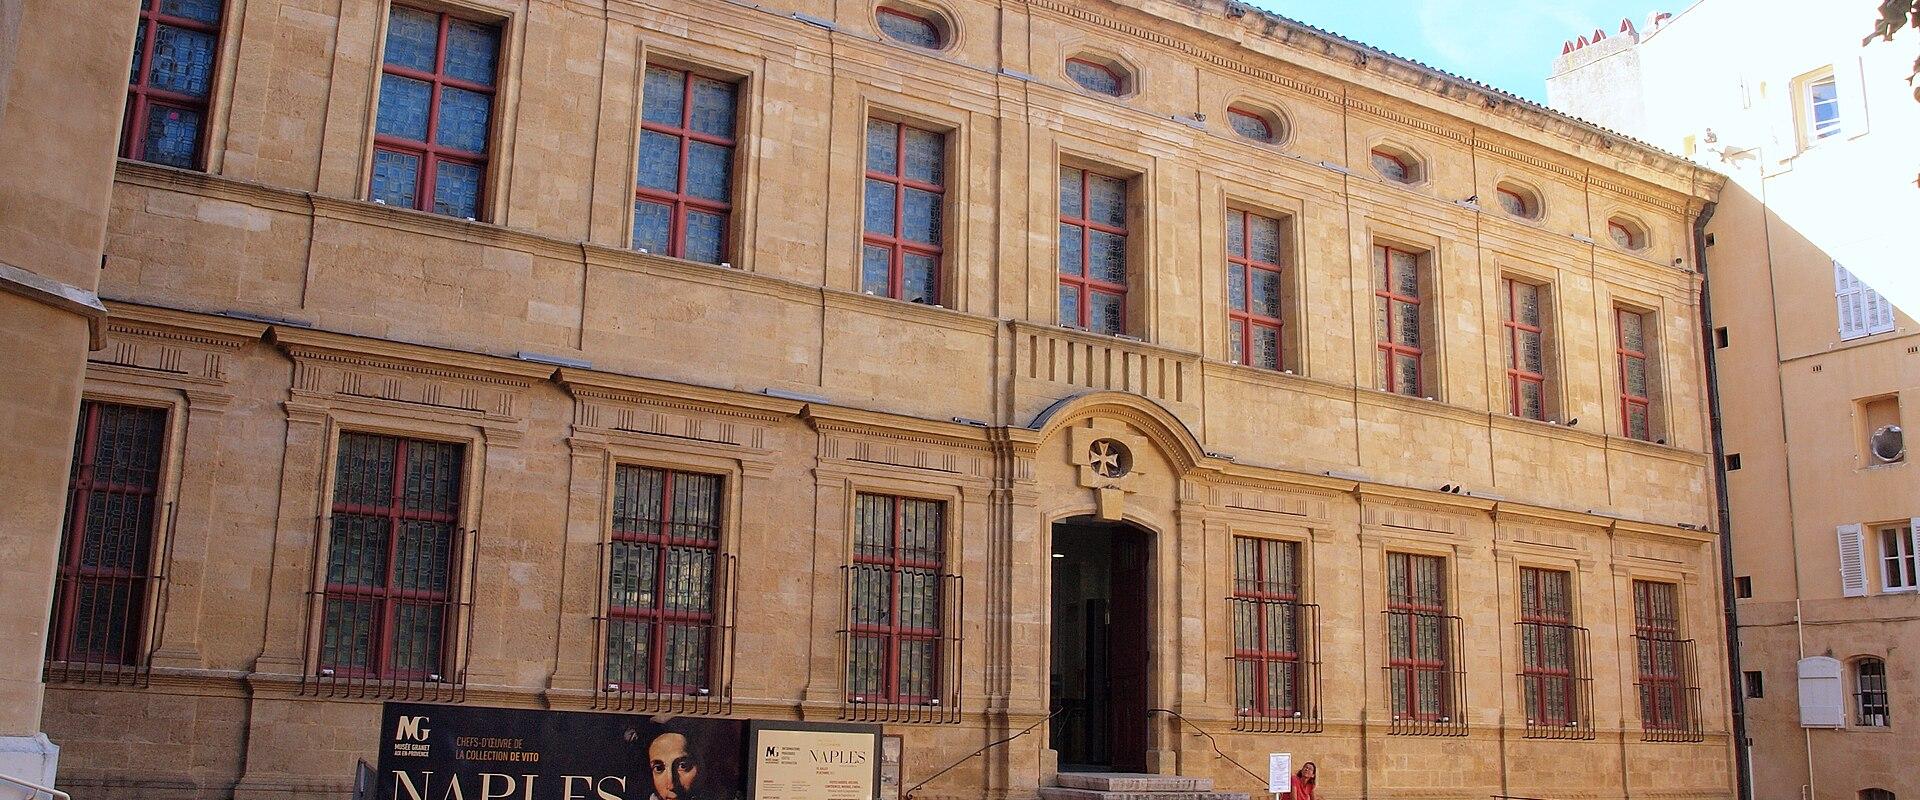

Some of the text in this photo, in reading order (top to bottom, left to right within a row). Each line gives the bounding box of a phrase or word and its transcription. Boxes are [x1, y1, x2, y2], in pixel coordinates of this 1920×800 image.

[396, 716, 431, 741] MG
[456, 737, 523, 749] CHEFS-D'ŒUVRE DE
[456, 750, 540, 762] LA COLLECTION DE VITO
[809, 750, 866, 764] NAPLES
